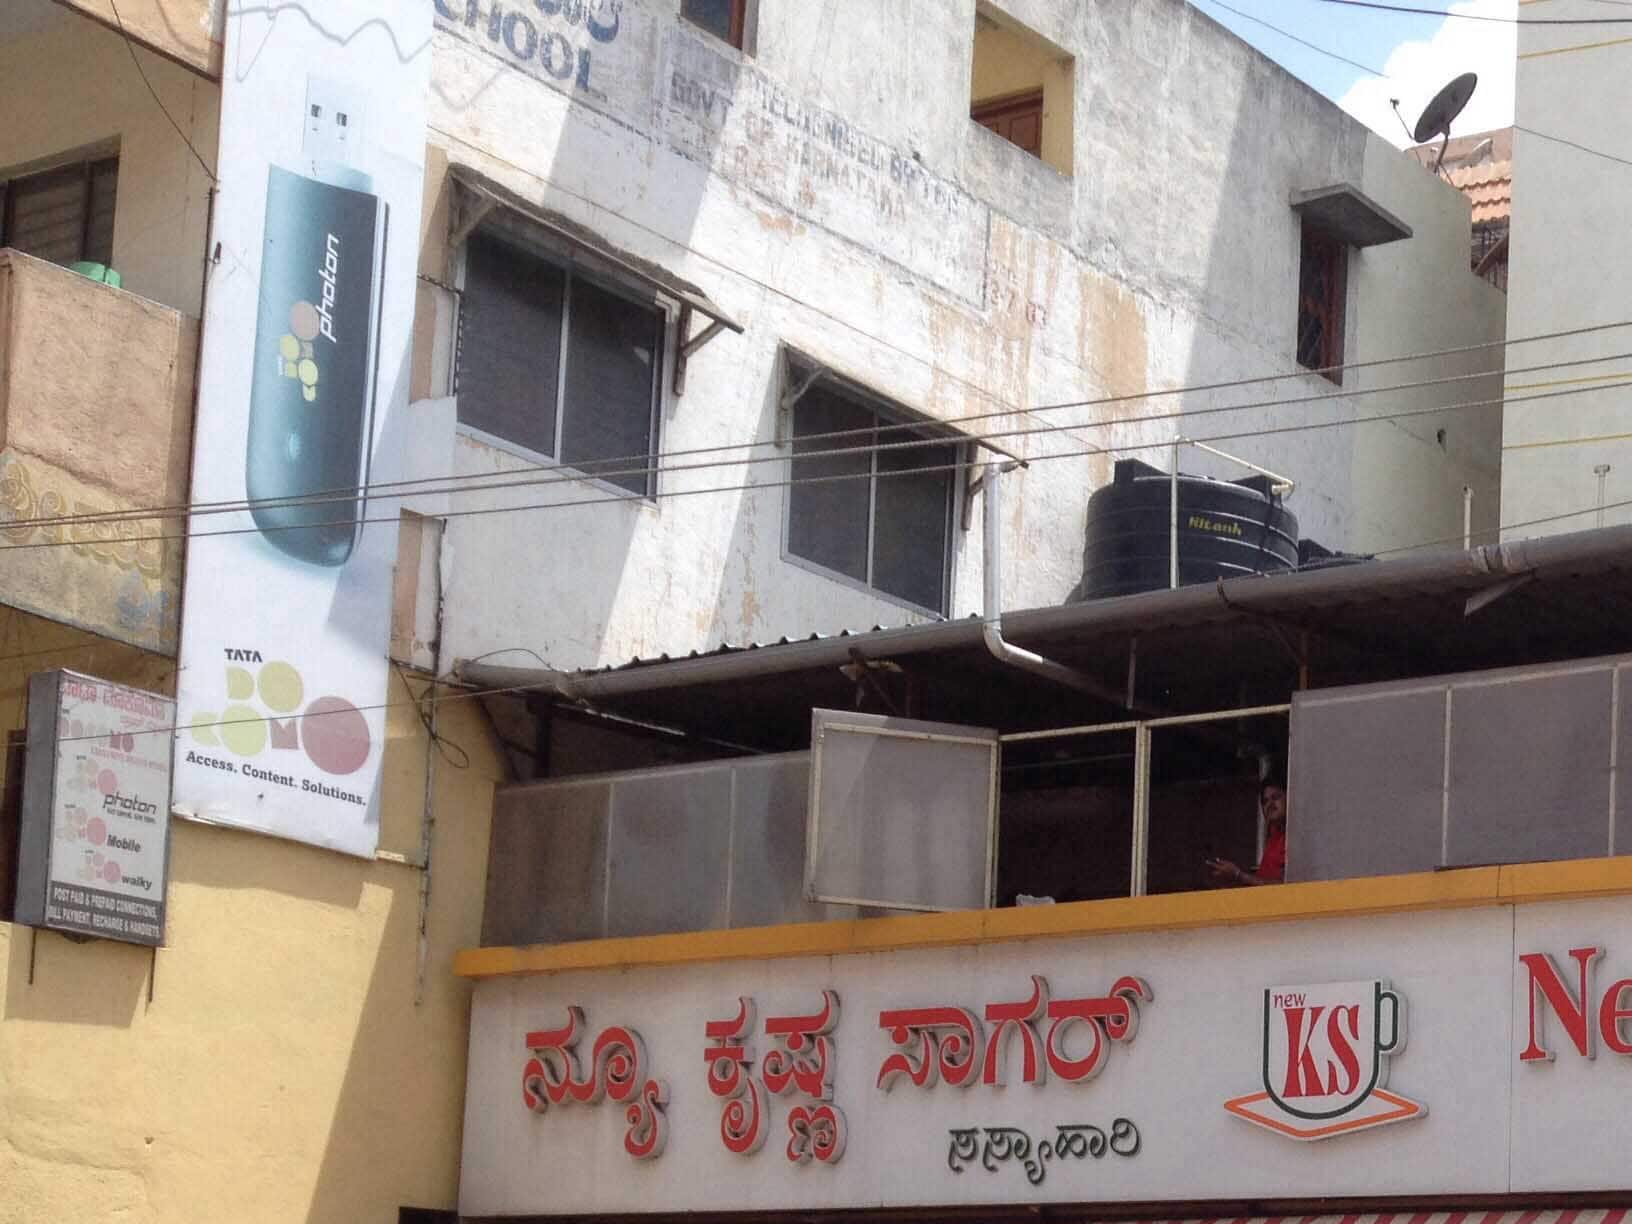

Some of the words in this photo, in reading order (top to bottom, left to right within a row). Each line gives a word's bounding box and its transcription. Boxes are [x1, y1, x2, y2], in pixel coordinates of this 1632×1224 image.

[315, 233, 340, 343] photon
[224, 648, 263, 663] TATA
[186, 750, 238, 774] Access.
[242, 763, 298, 788] Content.
[301, 778, 367, 806] Solutions.
[102, 791, 157, 815] photon
[106, 834, 141, 853] Mobile
[121, 875, 152, 891] walky
[54, 887, 69, 902] POST
[70, 889, 84, 904] PAID
[1273, 990, 1307, 1009] new
[1281, 1003, 1361, 1099] KS
[522, 1006, 667, 1161] ನ್ಯೂ
[704, 989, 846, 1163] ಕೃಷ್ಣ
[877, 975, 1152, 1089] ಸಾಗರ್
[947, 1118, 1142, 1185] ಸಸ್ಯಾಹಾರಿ
